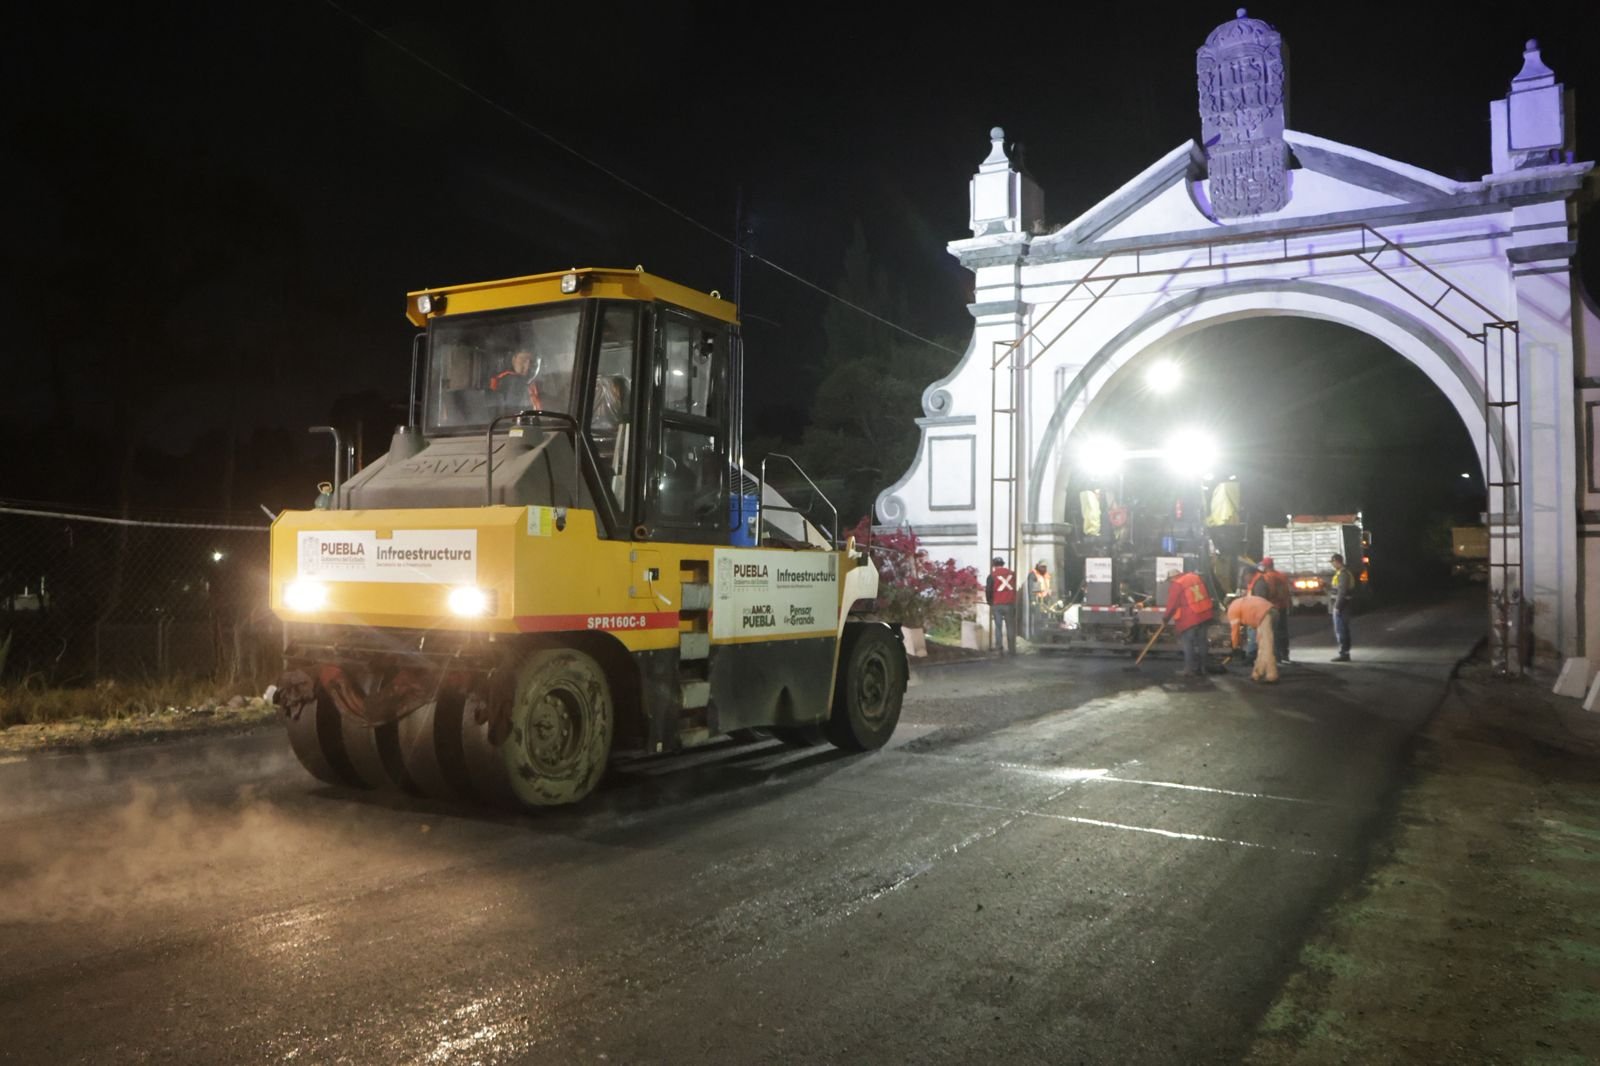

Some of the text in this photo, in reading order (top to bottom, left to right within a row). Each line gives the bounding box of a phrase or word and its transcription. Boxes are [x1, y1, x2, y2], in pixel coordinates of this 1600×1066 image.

[321, 542, 365, 556] PUEBLA
[376, 546, 472, 561] Infraestructura
[733, 564, 769, 578] PUEBLA
[776, 568, 836, 582] Infraestructura
[790, 604, 812, 616] Pensar
[587, 616, 646, 629] SPR160C-8
[742, 614, 776, 629] PUEBLA
[790, 615, 815, 626] Grande
